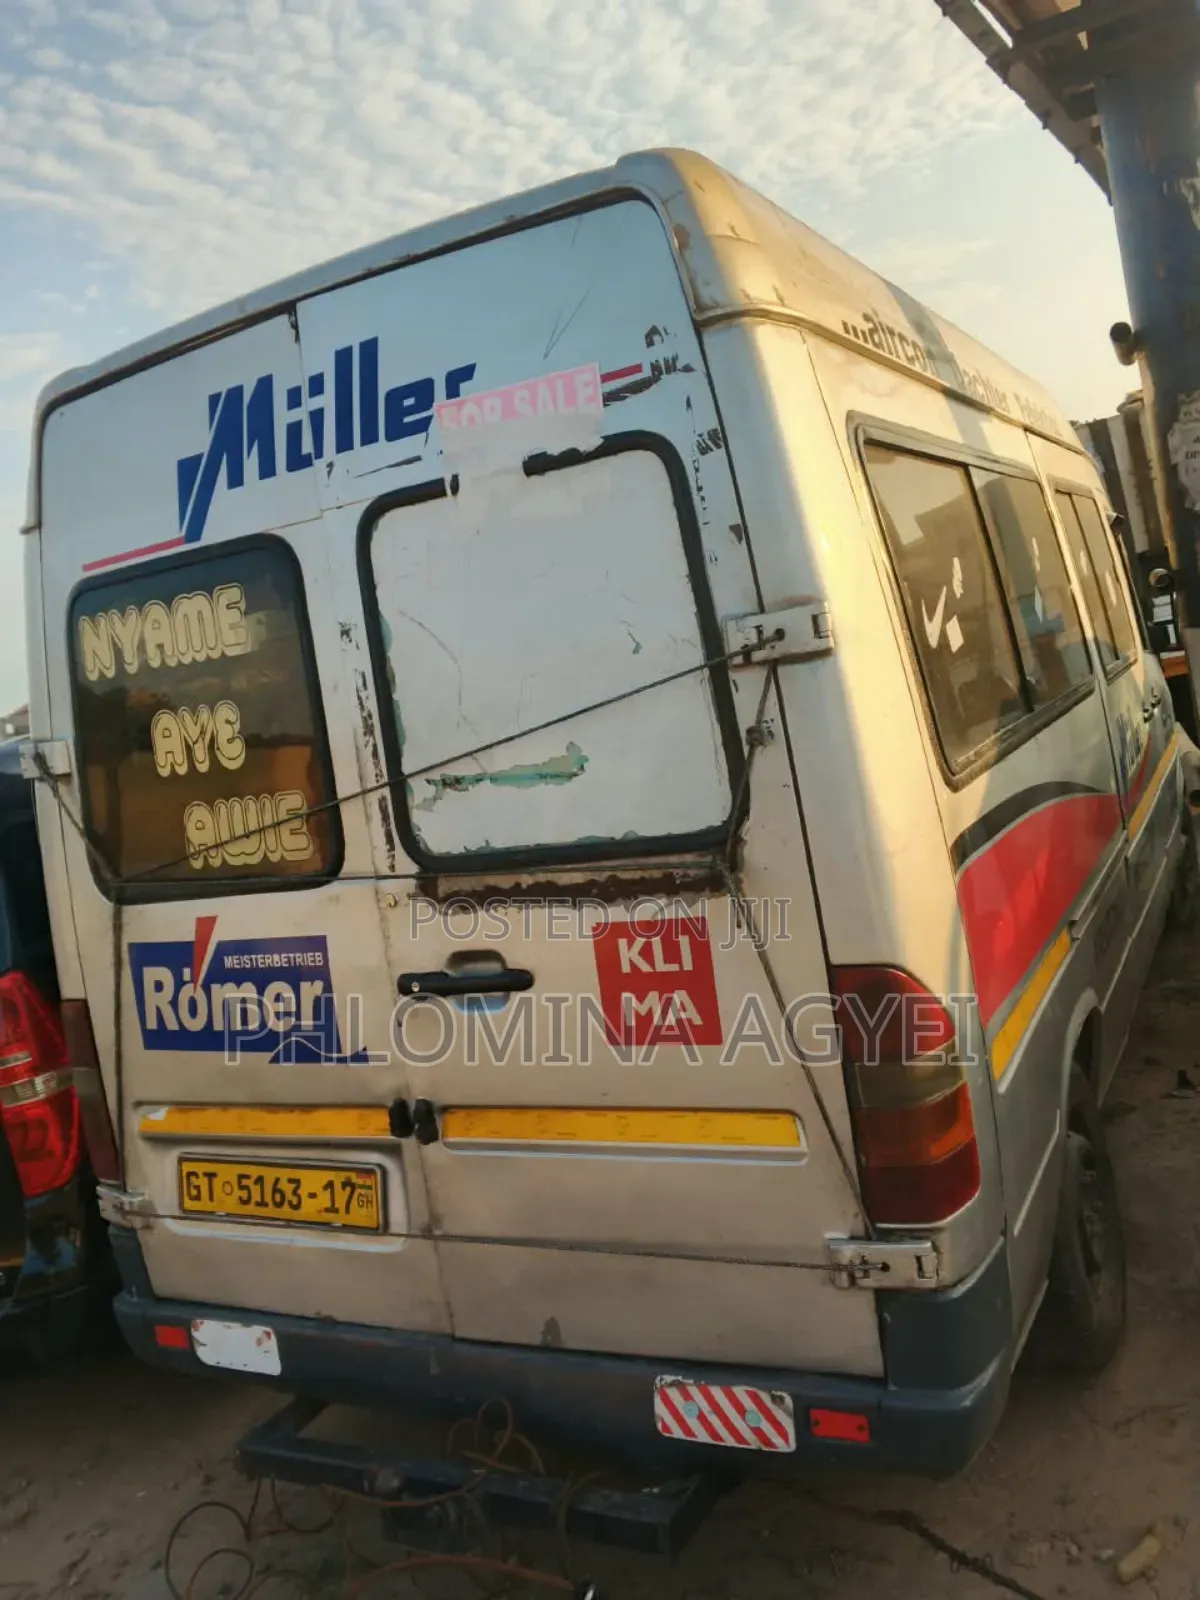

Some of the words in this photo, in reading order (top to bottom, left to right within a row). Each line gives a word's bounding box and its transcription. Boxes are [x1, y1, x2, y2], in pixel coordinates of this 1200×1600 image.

[514, 371, 596, 416] SALE
[177, 336, 477, 542] Müller
[79, 583, 250, 681] NYAME
[152, 700, 246, 777] AYE
[184, 790, 314, 869] AWIE
[223, 952, 324, 969] MEISTERBETRIEB
[618, 935, 694, 974] KLI
[622, 989, 704, 1028] MA
[185, 1170, 217, 1203] GT
[236, 1173, 357, 1215] 5163-17
